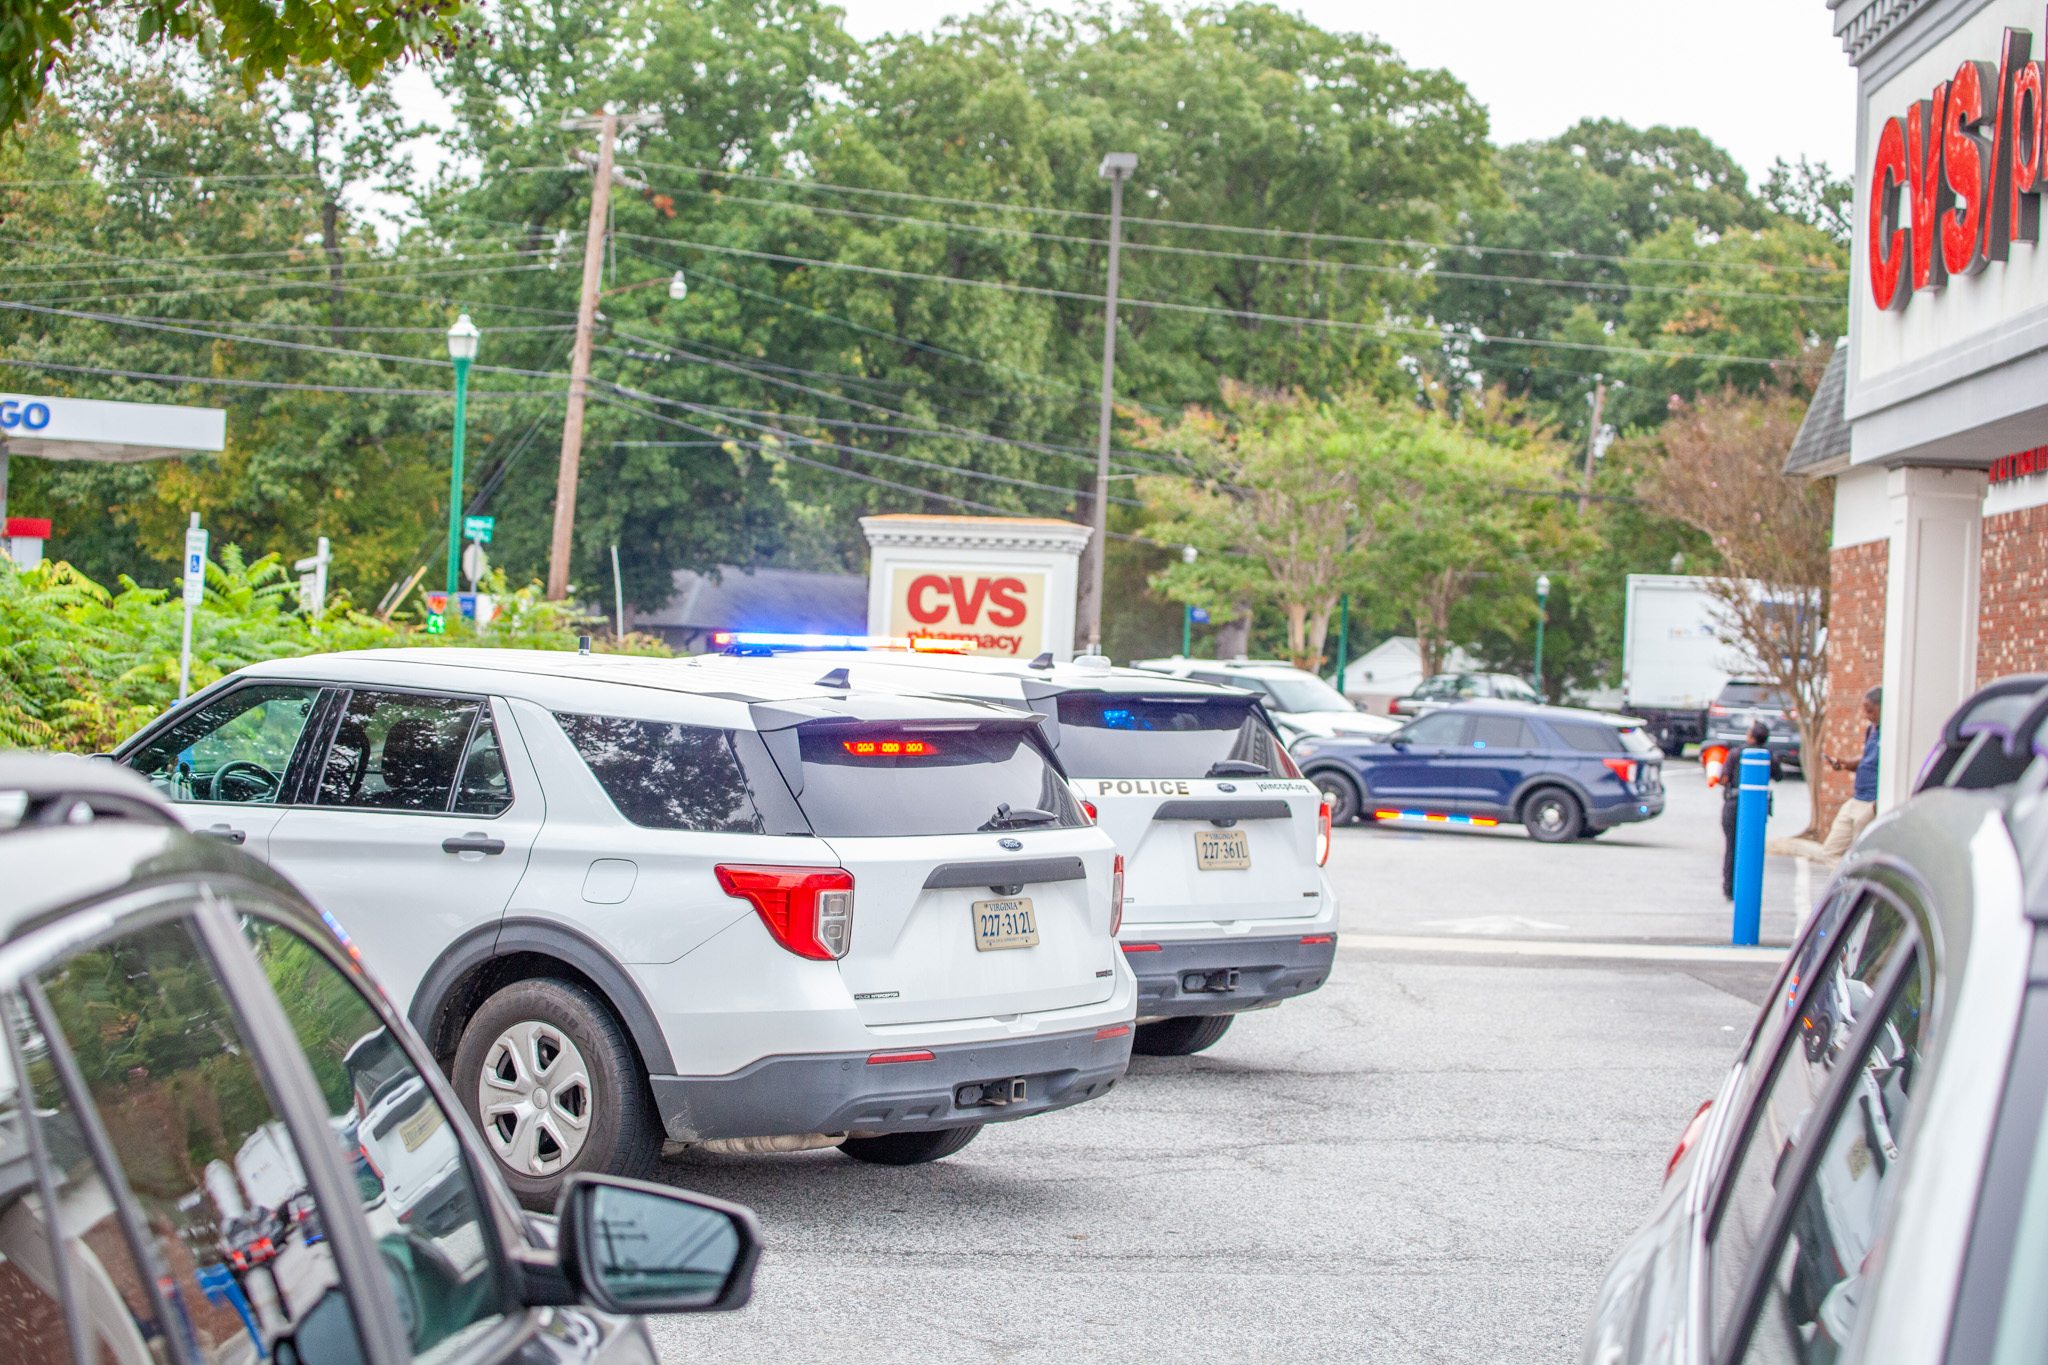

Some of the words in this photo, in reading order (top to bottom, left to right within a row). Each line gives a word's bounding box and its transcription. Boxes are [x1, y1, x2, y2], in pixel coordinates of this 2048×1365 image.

[1869, 3, 2048, 312] CVS/p
[907, 575, 1027, 627] CVS
[1098, 780, 1190, 796] POLICE
[989, 902, 1018, 912] VIRGINIA
